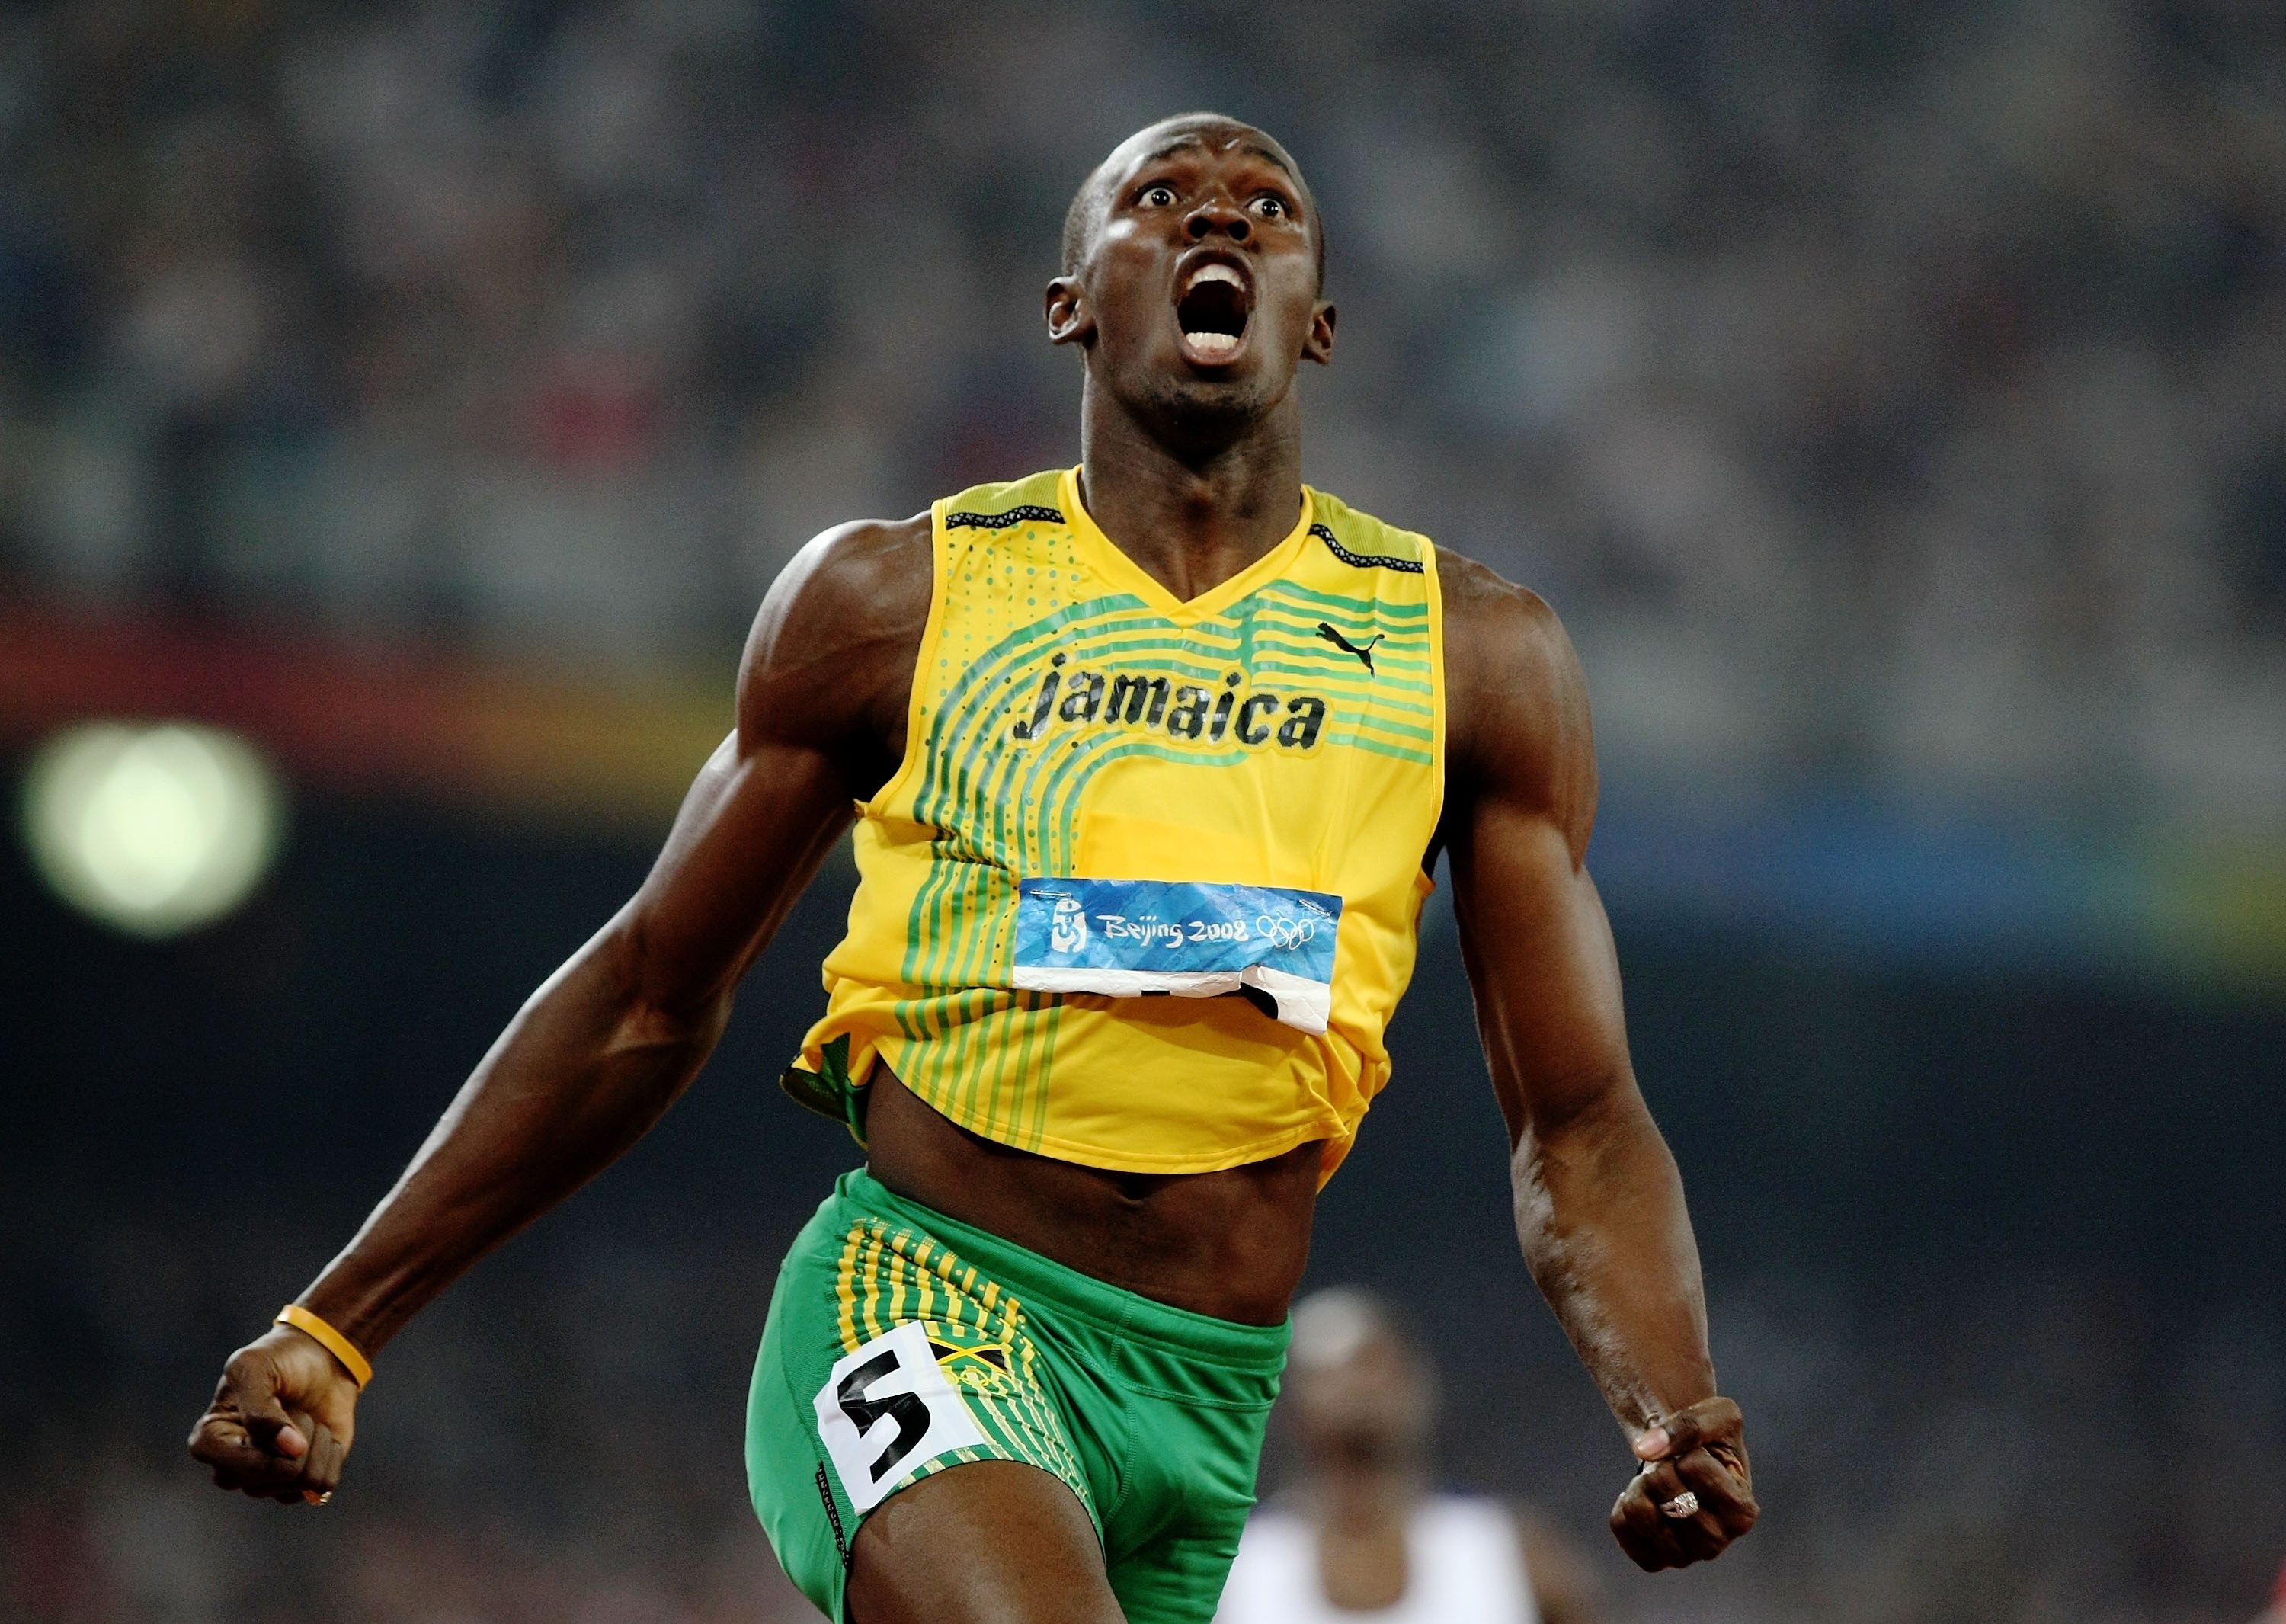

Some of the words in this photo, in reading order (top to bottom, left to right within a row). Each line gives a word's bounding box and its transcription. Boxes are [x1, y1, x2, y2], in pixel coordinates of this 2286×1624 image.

[1013, 652, 1327, 750] jamaica
[1095, 915, 1184, 949] Beijing
[1187, 919, 1250, 943] 2008
[837, 1349, 931, 1485] 5
